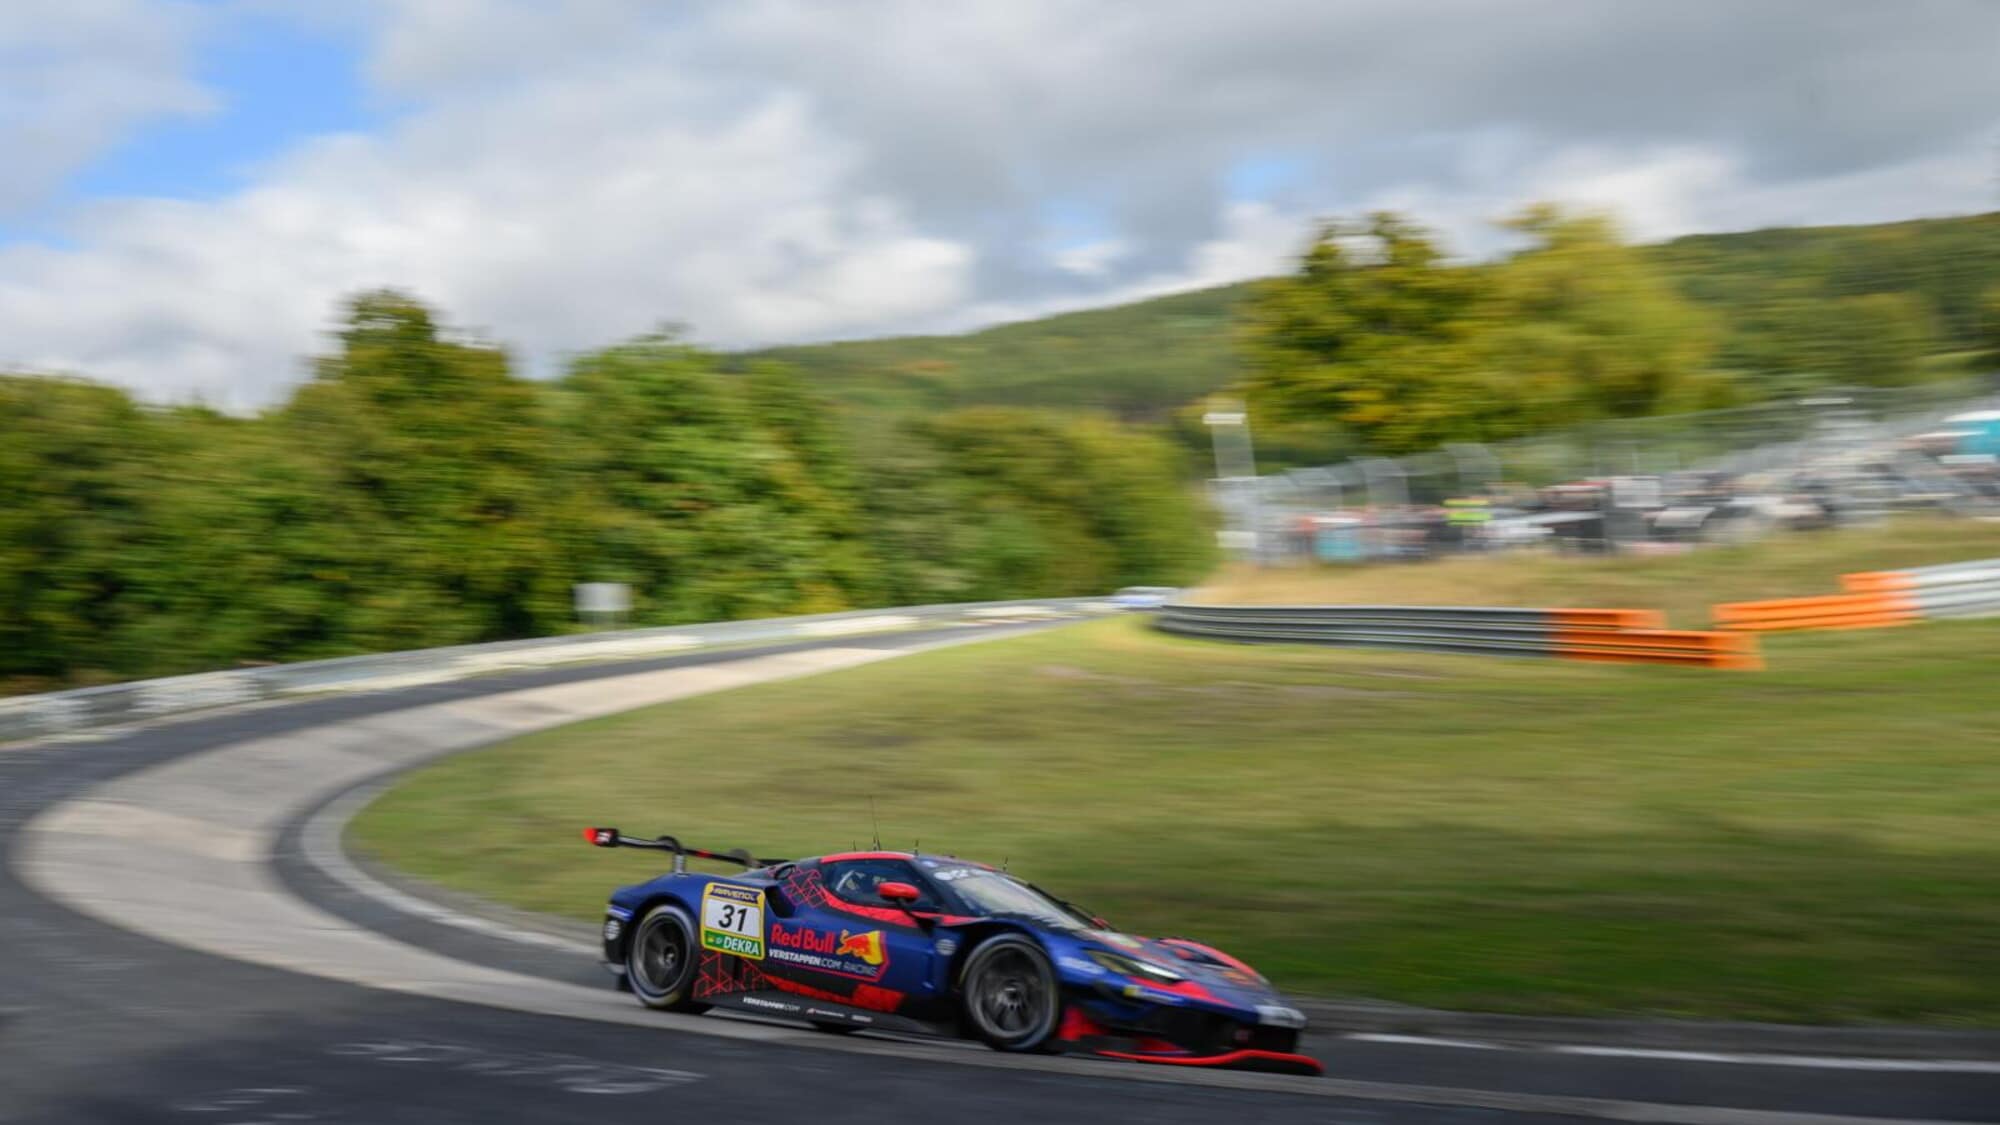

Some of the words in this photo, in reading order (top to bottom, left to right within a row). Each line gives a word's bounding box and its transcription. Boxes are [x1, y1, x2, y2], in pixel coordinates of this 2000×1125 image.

[718, 904, 747, 932] 31
[723, 936, 759, 955] DEKRA
[771, 924, 802, 947] Red
[803, 929, 835, 953] Bull
